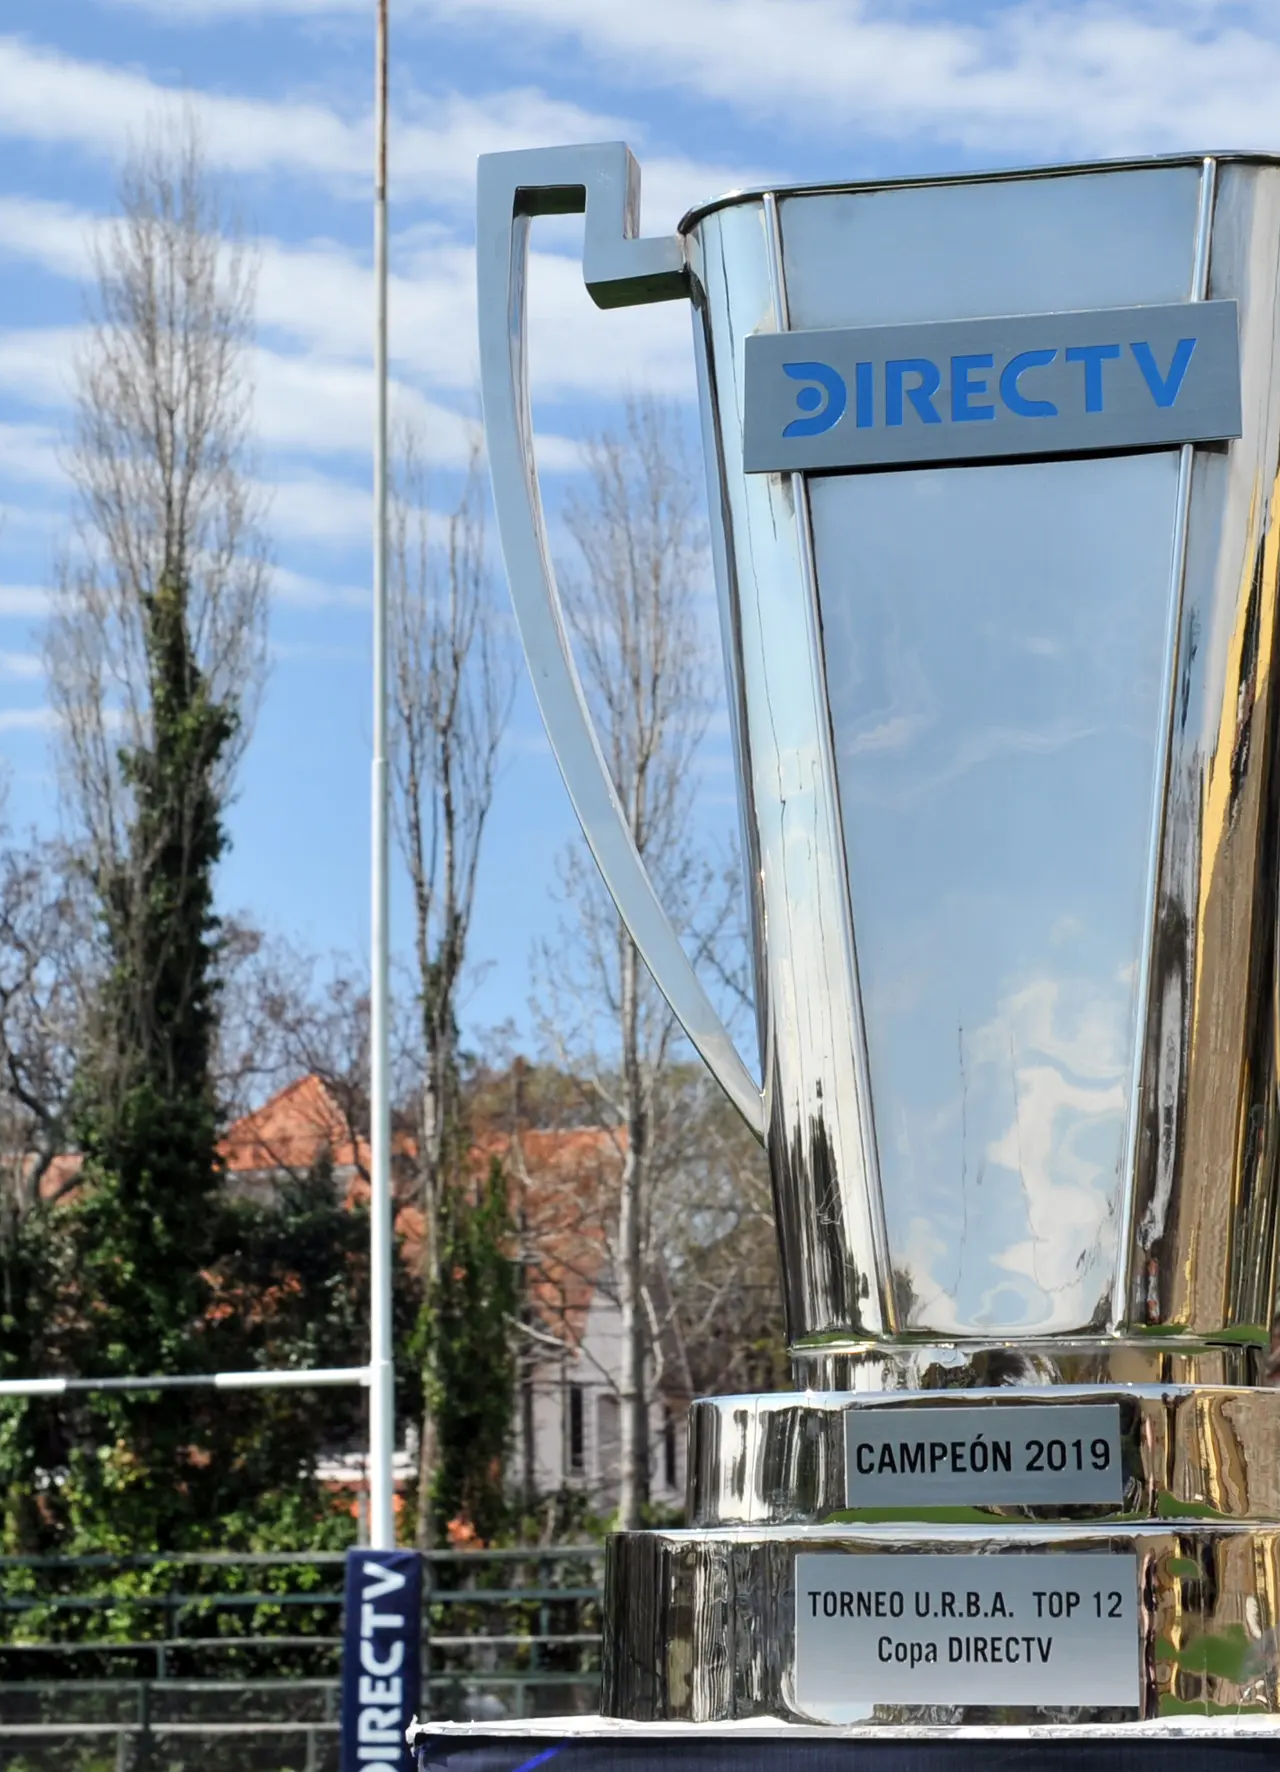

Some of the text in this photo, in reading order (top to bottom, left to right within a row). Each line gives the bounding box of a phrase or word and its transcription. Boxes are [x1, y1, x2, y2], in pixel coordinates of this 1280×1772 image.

[781, 337, 1198, 438] DIRECTV
[856, 1434, 1111, 1474] CAMPEÓN 2019
[808, 1591, 1123, 1618] TORNEO U.R.B.A. TOP 12
[358, 1561, 406, 1772] IRECTV
[877, 1636, 1053, 1668] Copa DIRECTV
